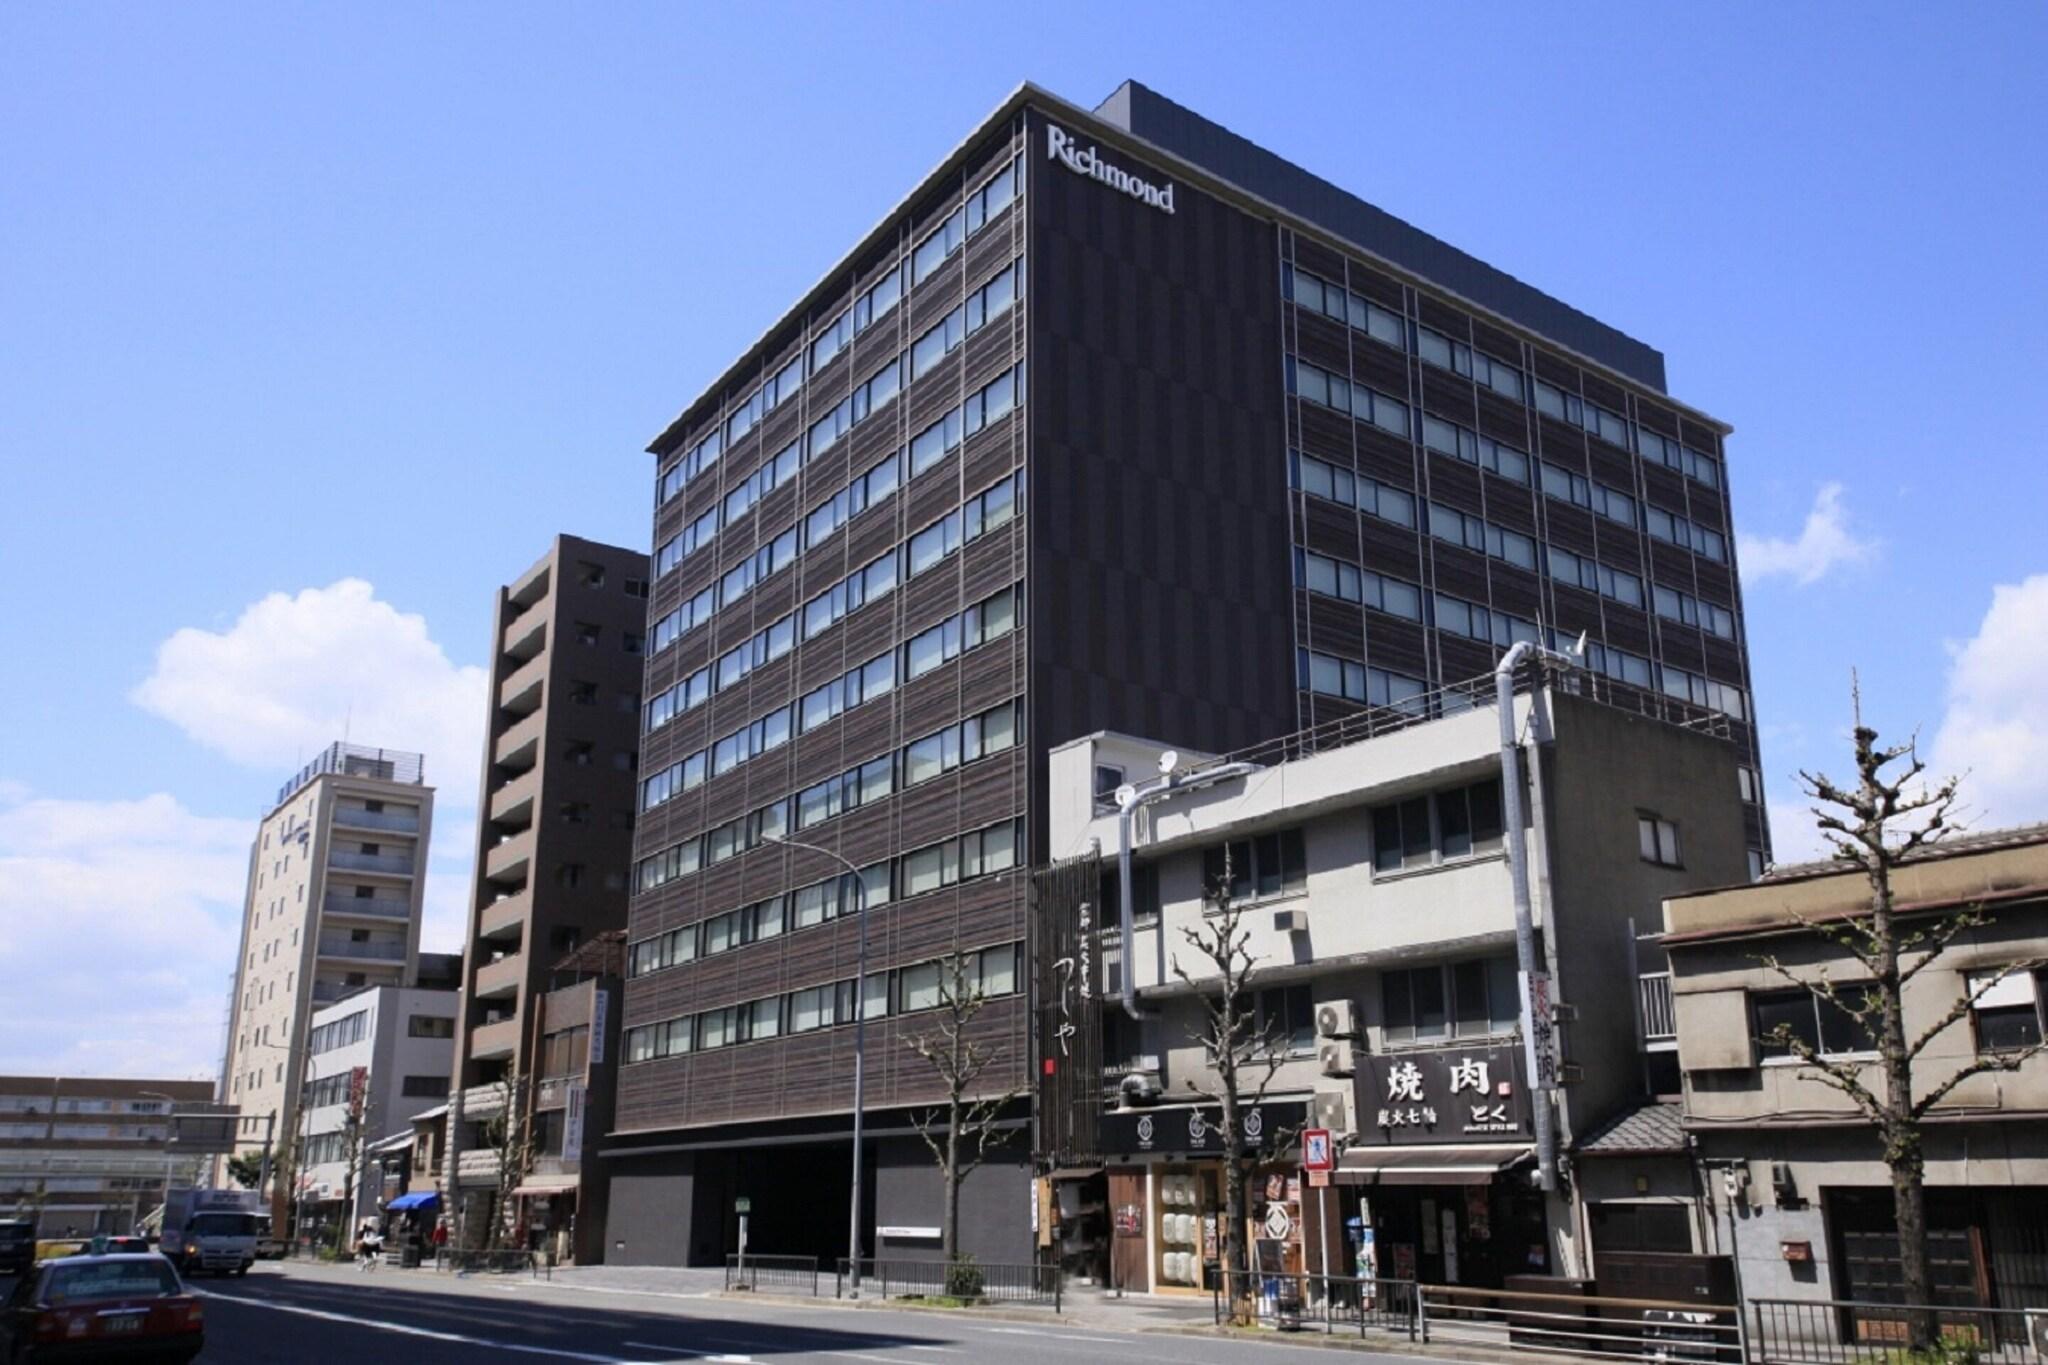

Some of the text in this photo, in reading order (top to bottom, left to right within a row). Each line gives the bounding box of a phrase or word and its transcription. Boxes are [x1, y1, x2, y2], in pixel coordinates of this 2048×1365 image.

[1046, 123, 1176, 215] Richmond
[1387, 1057, 1490, 1101] 焼肉
[1470, 1103, 1507, 1122] とく
